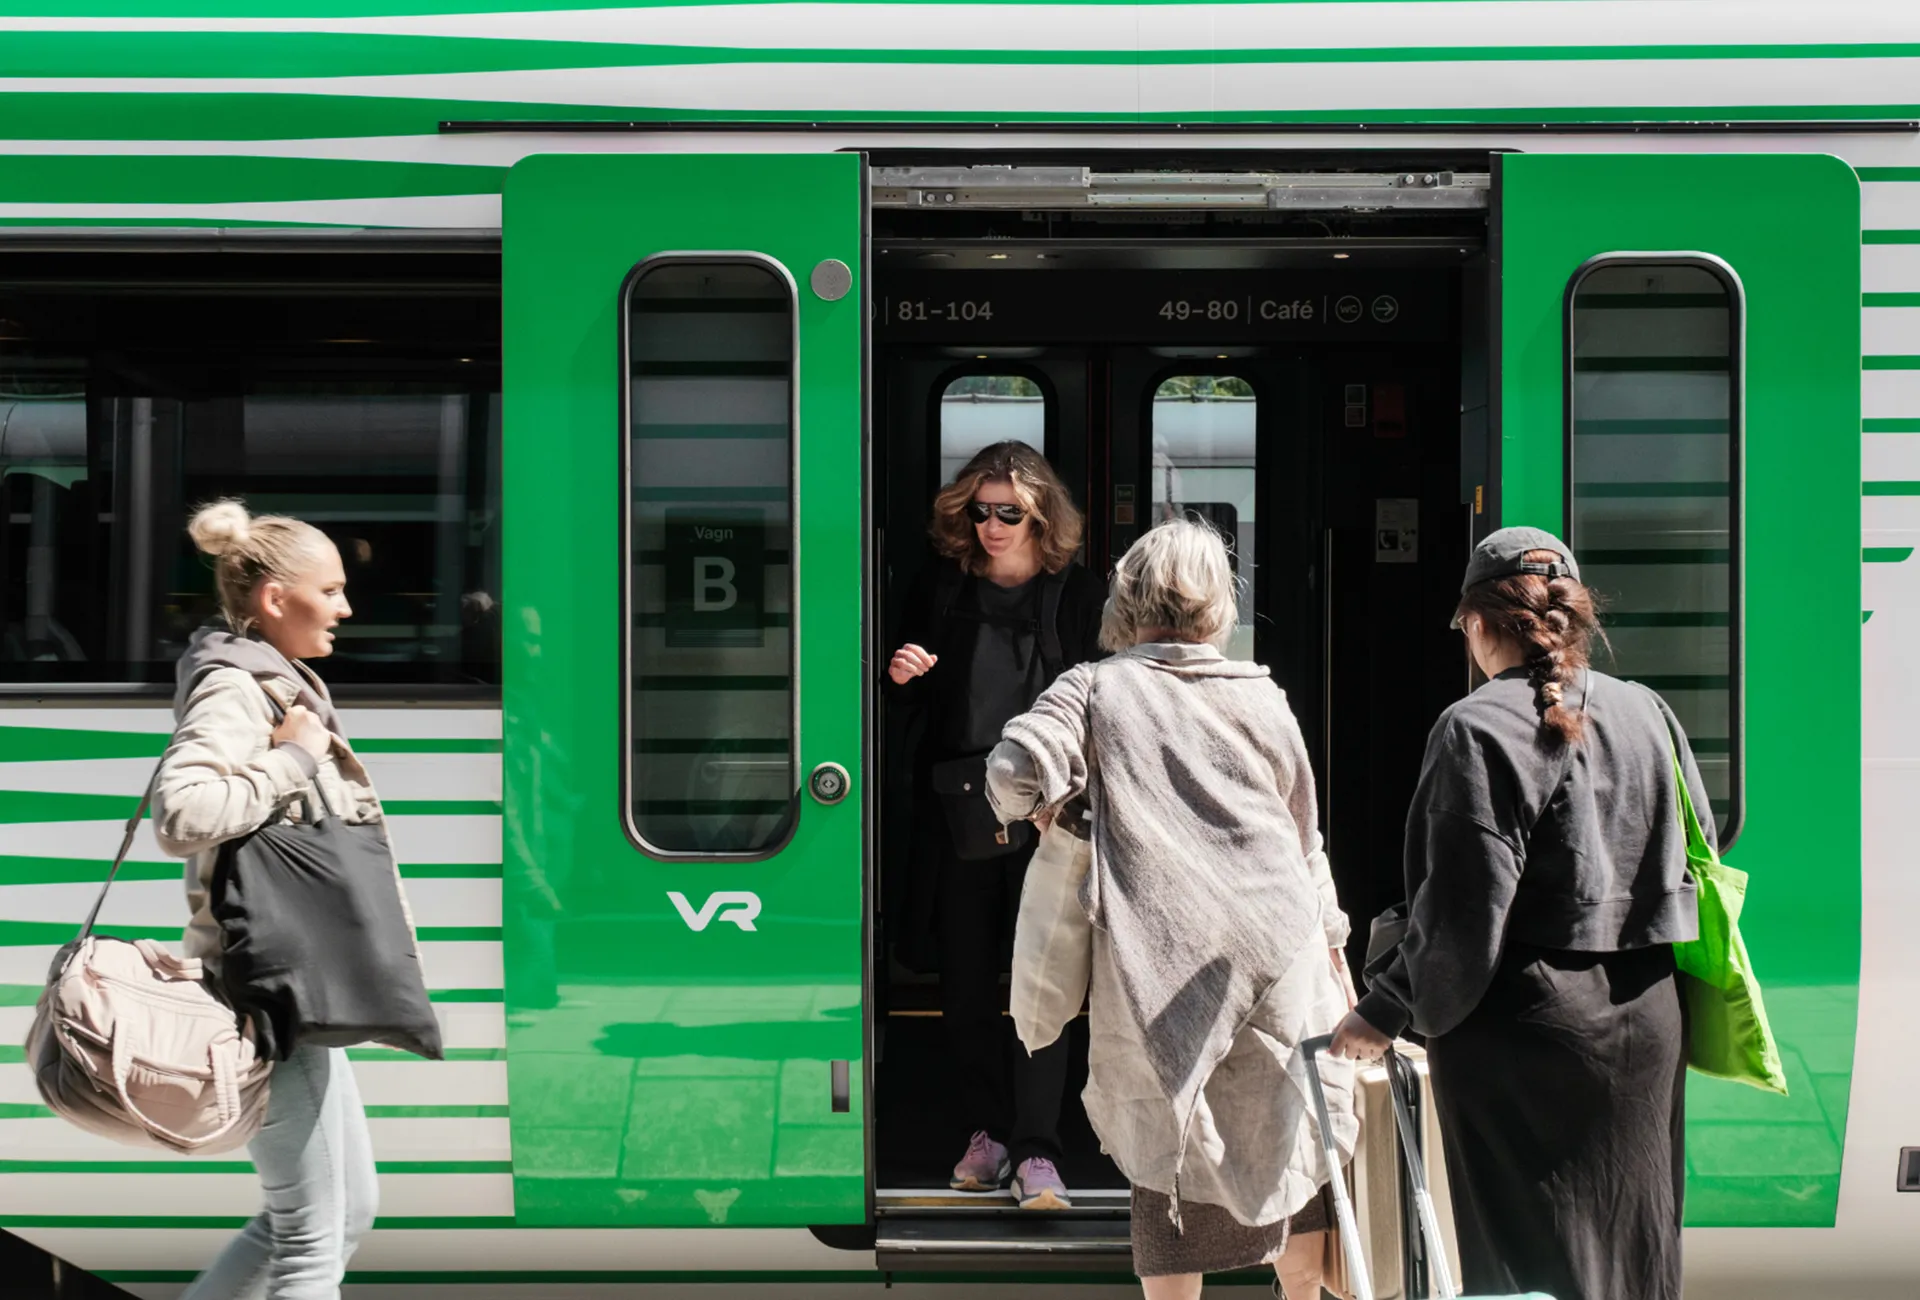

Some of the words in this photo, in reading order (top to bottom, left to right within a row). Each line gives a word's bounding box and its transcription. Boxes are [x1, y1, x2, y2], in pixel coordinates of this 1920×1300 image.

[1260, 300, 1314, 320] Café
[694, 526, 733, 542] Vagn
[693, 556, 738, 612] B
[666, 891, 762, 932] VR
